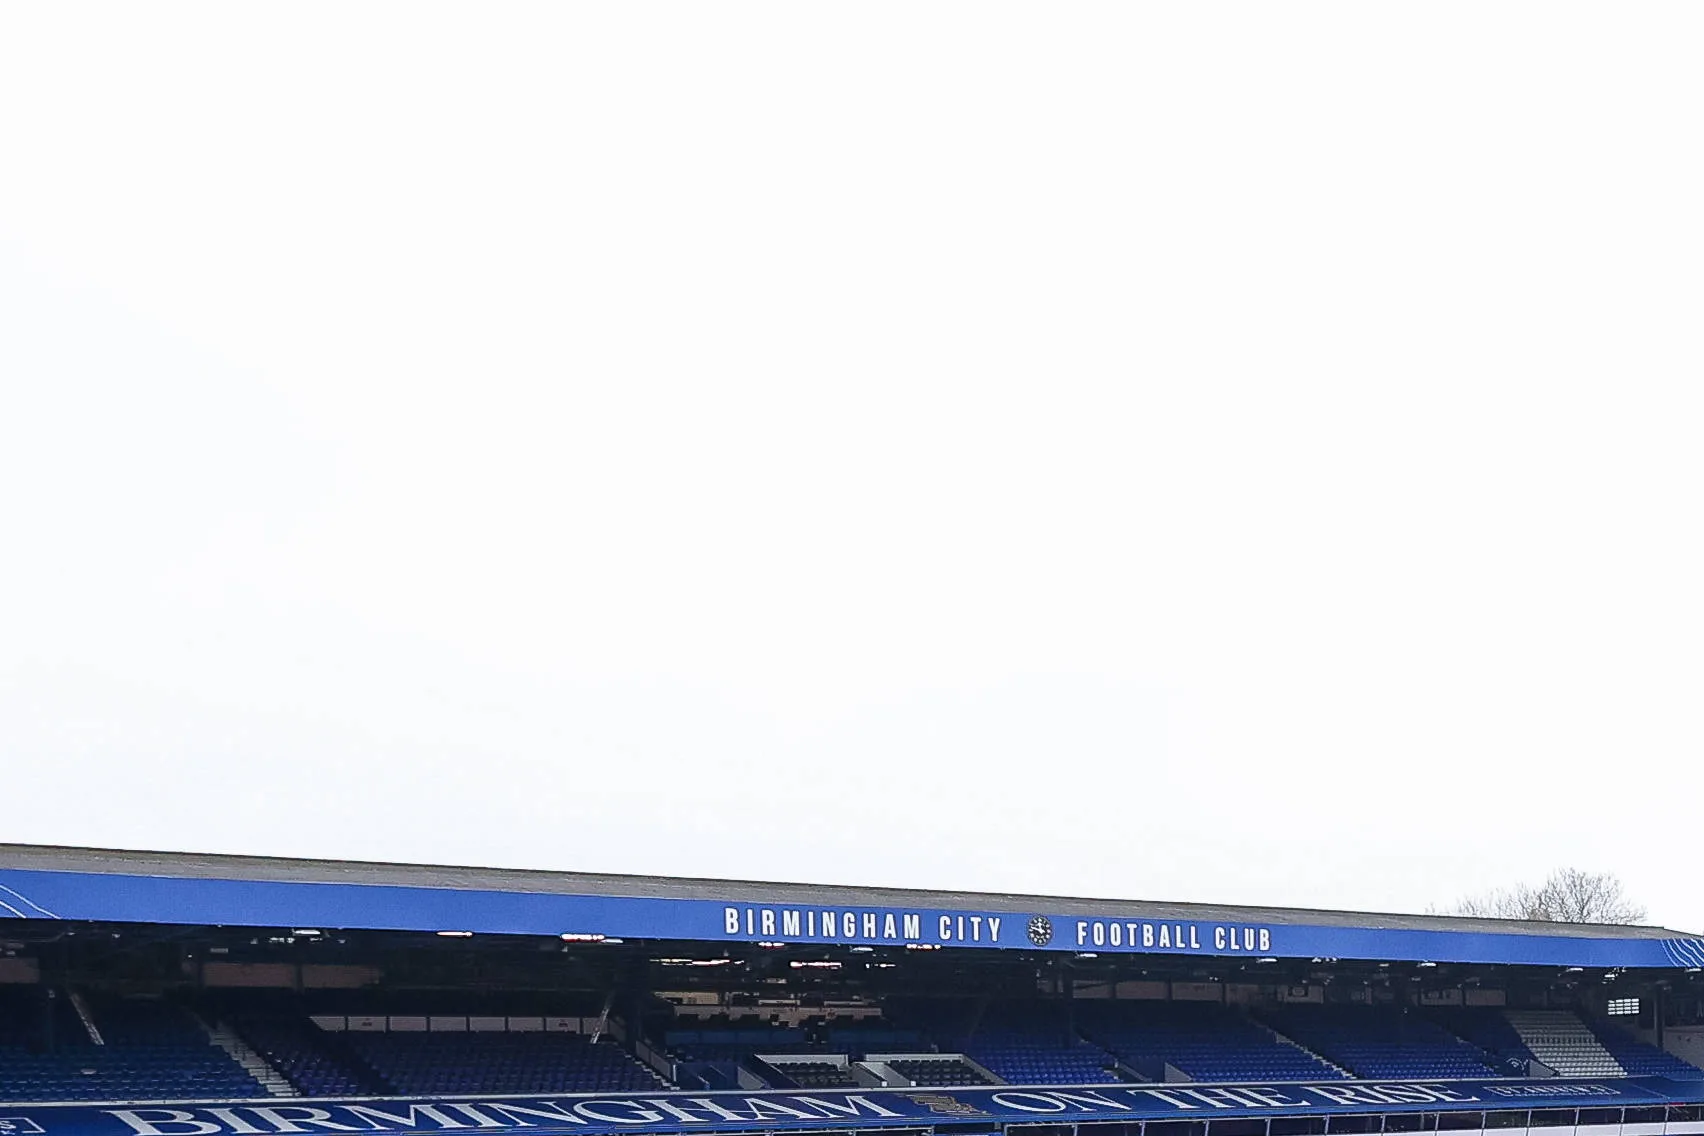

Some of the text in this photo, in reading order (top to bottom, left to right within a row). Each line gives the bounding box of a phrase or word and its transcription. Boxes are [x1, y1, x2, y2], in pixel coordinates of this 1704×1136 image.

[723, 907, 1002, 942] BIRMINGHAM CITY
[1077, 921, 1271, 951] FOOTBALL CLUB
[101, 1095, 905, 1136] BIRMINGHAM
[991, 1091, 1132, 1113] ON
[1128, 1088, 1308, 1109] THE
[1305, 1084, 1481, 1105] RISE
